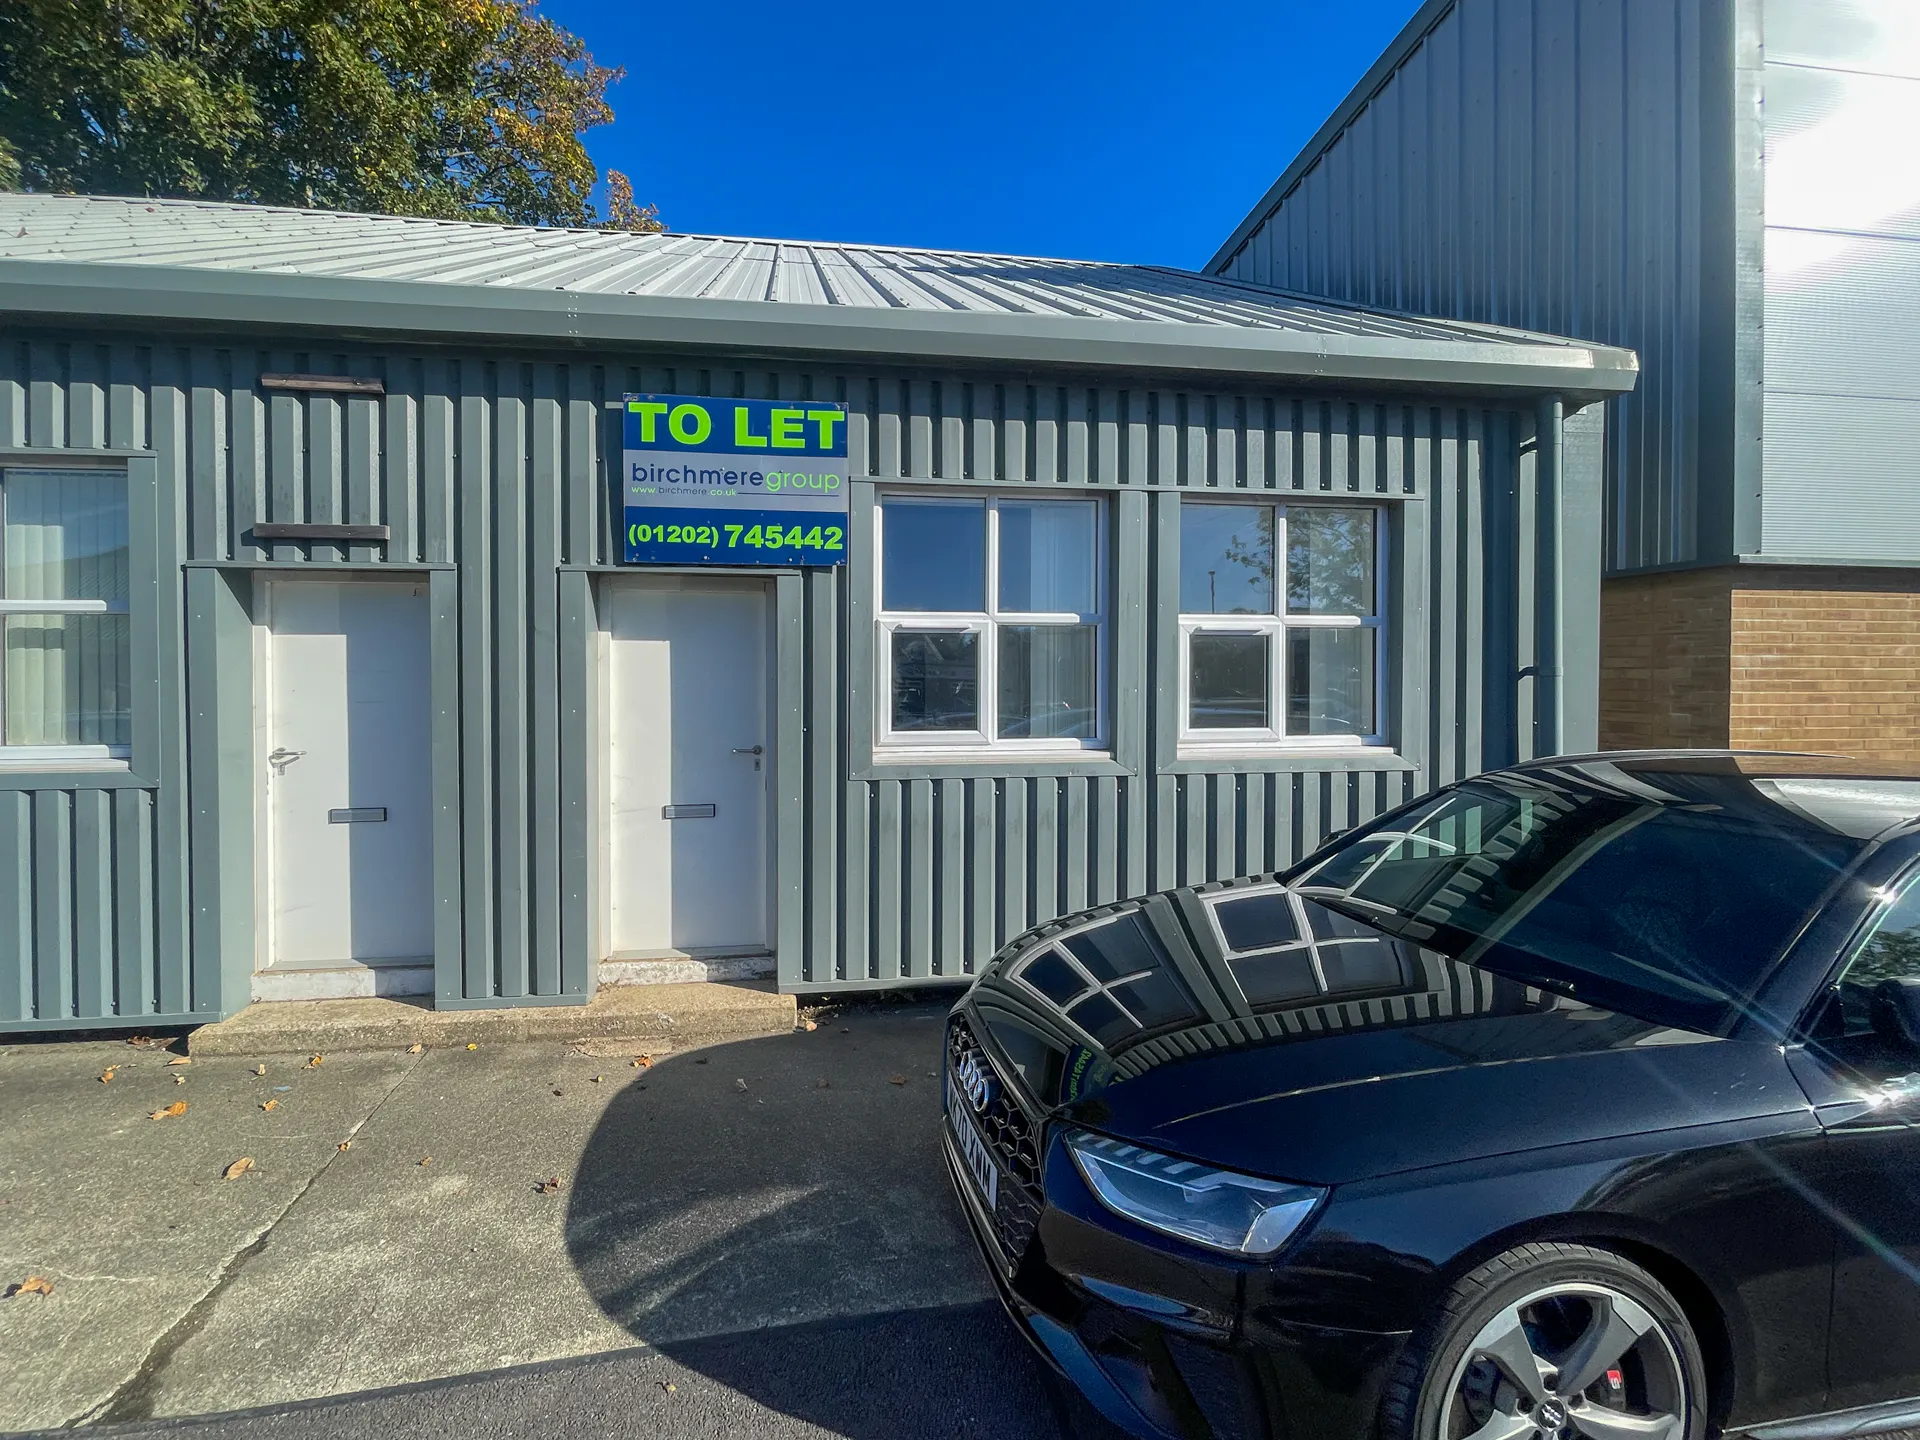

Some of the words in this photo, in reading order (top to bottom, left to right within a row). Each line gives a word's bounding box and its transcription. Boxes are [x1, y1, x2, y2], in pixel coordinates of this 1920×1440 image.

[628, 401, 712, 445] TO
[734, 407, 845, 449] LET
[631, 485, 737, 497] www.birchmere.co.uk
[628, 524, 719, 548] (01202)
[724, 525, 843, 550] 745442
